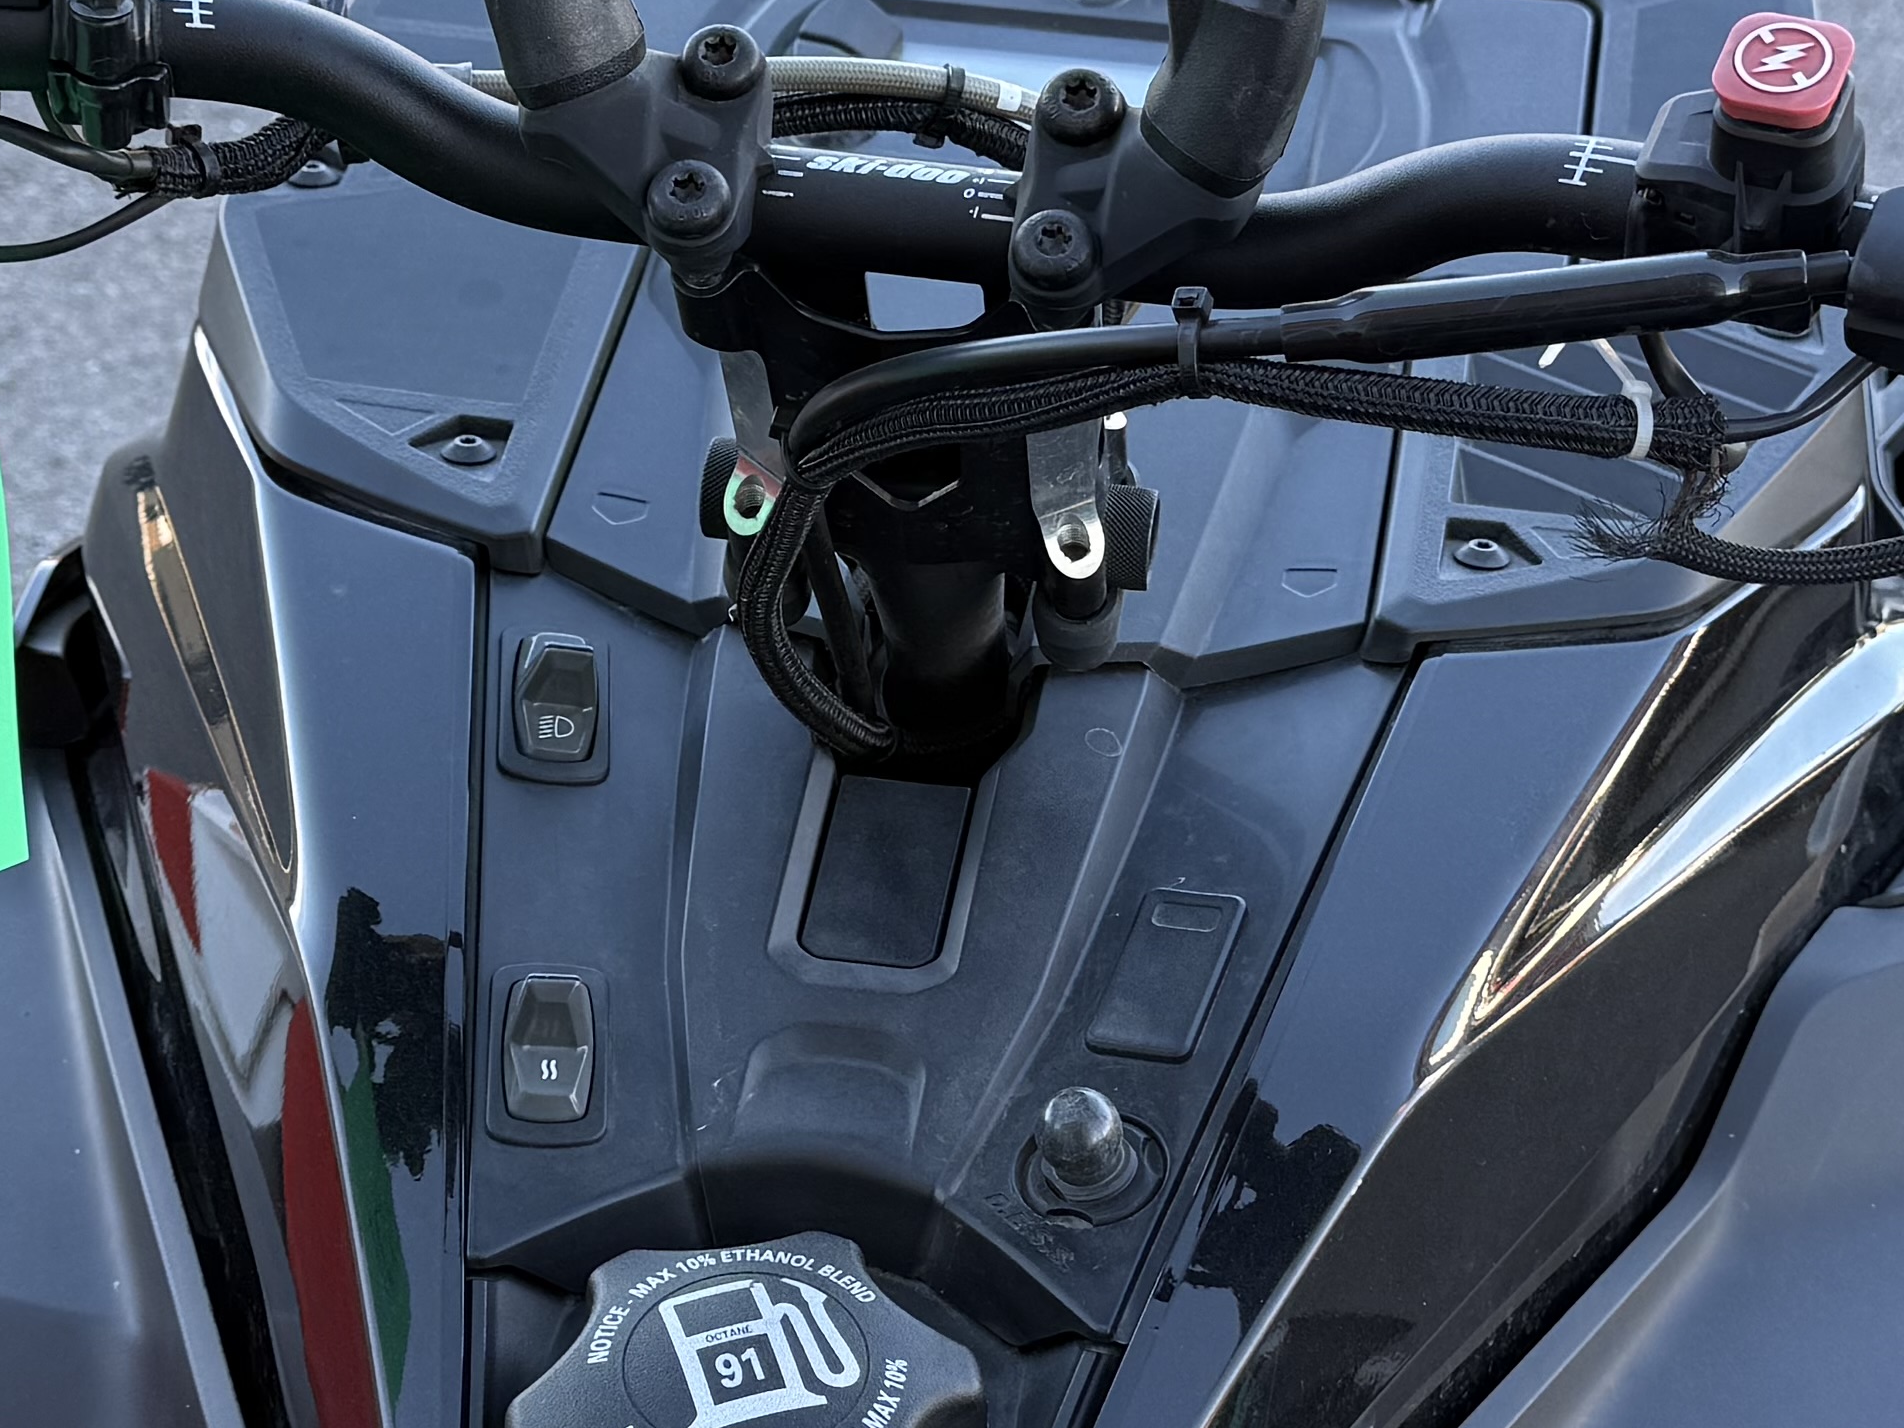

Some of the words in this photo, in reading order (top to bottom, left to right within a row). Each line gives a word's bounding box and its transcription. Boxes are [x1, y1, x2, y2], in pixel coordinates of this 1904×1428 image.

[806, 154, 971, 185] ski-doo
[587, 1305, 631, 1365] NOTICE
[629, 1267, 678, 1303] MAX
[676, 1252, 717, 1277] 10%
[720, 1247, 816, 1272] ETHANOL
[817, 1264, 876, 1304] BLEND
[704, 1324, 754, 1344] OCTANE
[714, 1346, 768, 1389] 91
[884, 1358, 909, 1391] 10%
